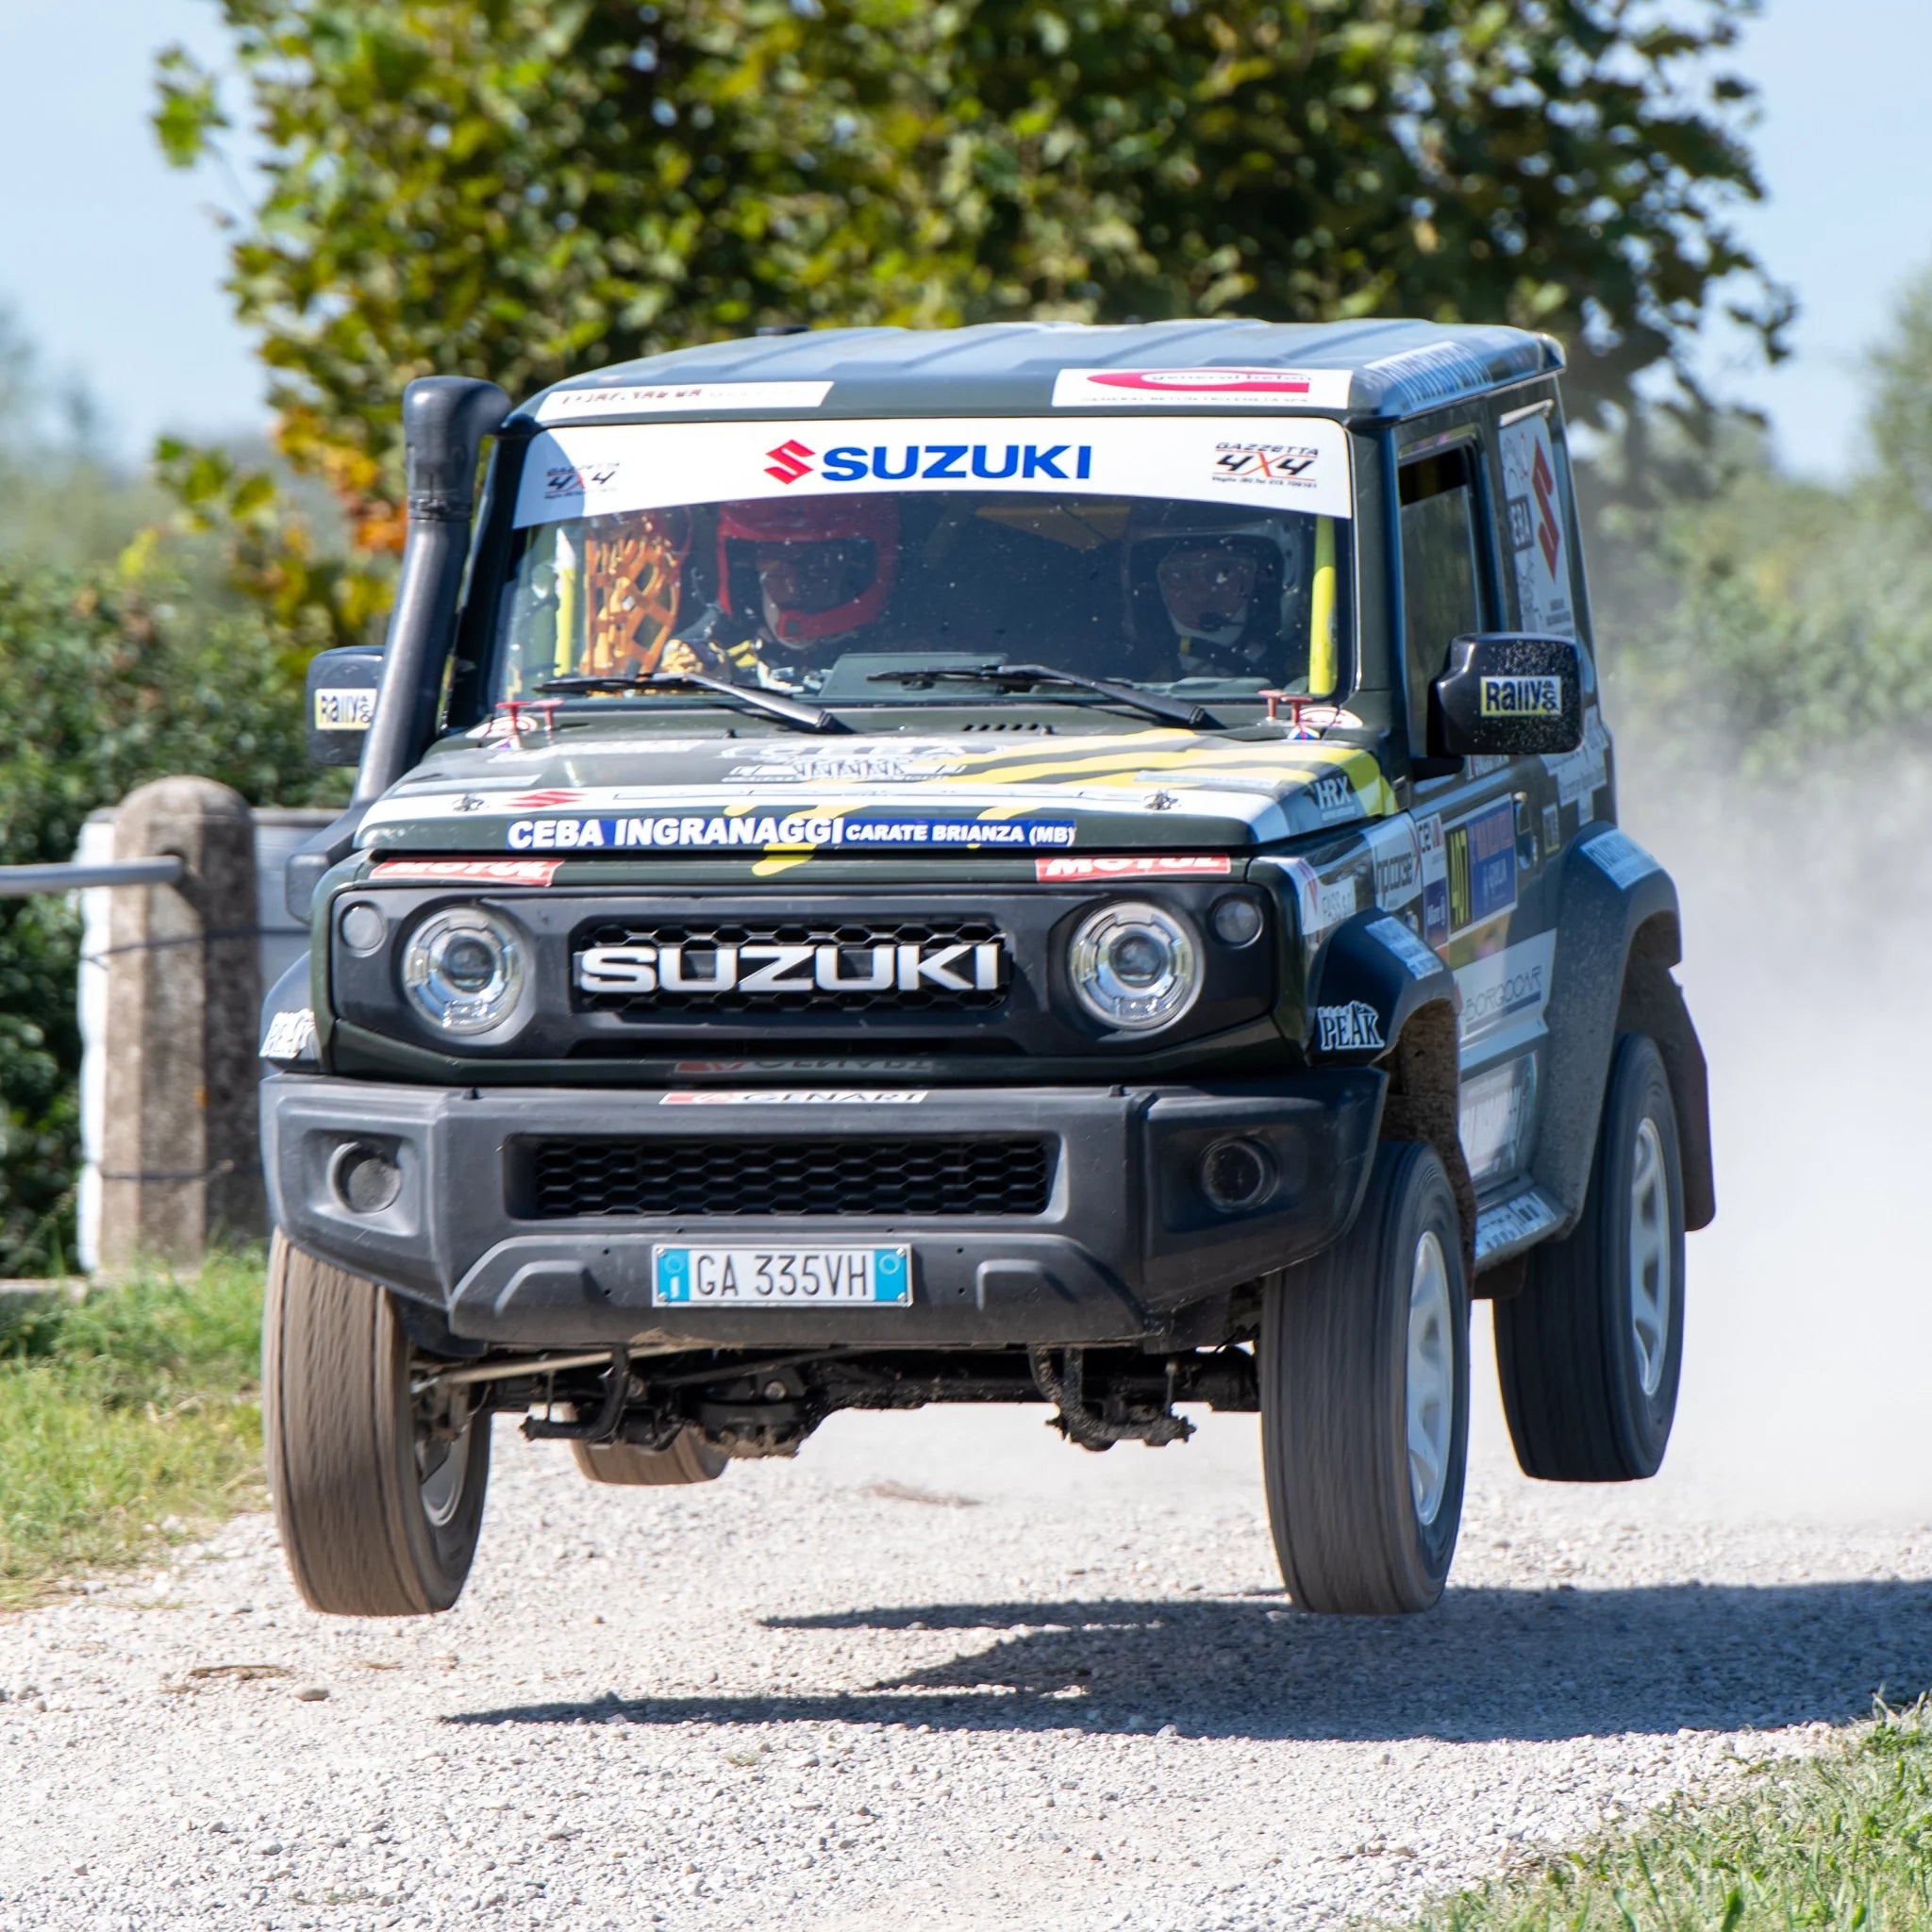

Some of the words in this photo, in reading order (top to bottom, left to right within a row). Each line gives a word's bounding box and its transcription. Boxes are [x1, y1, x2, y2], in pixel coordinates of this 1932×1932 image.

[822, 444, 1092, 482] SUZUKI
[1215, 442, 1319, 455] GAZZETTA
[1486, 680, 1543, 710] Rally
[1315, 775, 1352, 809] HRX
[508, 820, 606, 848] CEBA
[614, 817, 844, 847] INGRANAGGI
[846, 822, 927, 842] CARATE
[932, 823, 1025, 843] BRIANZA
[1029, 824, 1076, 846] (MB)
[580, 944, 999, 992] SUZUKI
[1322, 1004, 1381, 1046] PEAK
[697, 1255, 739, 1297] GA
[754, 1254, 868, 1297] 335VH
